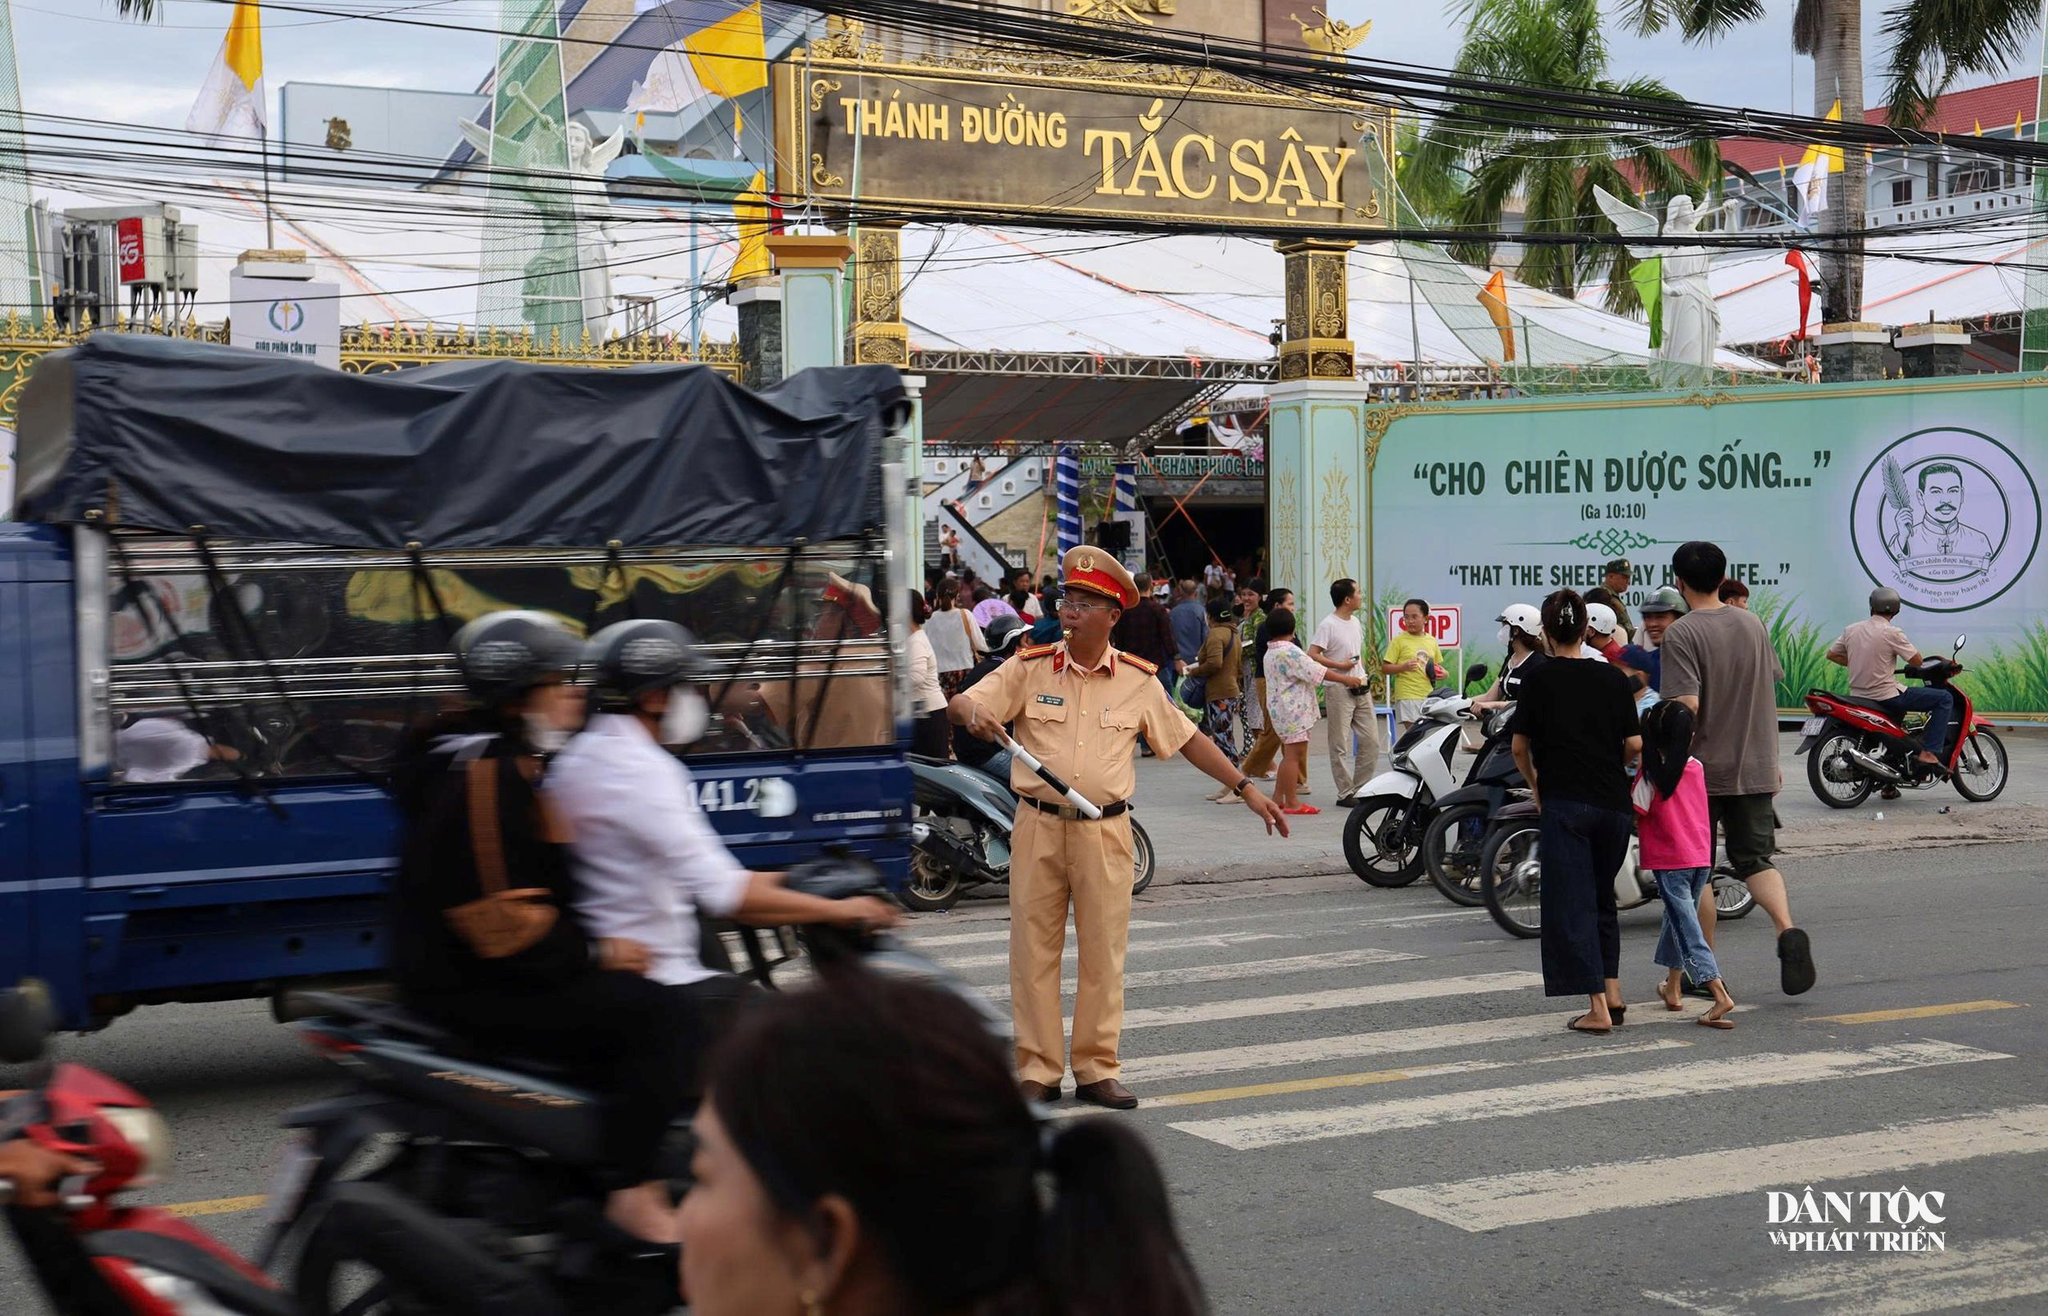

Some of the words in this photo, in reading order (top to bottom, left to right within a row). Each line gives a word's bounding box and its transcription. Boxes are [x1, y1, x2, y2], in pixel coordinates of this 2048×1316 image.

[840, 88, 949, 141] THÁNH
[961, 92, 1067, 149] ĐƯỜNG
[1083, 98, 1218, 200] TẮC
[1228, 126, 1356, 217] SẬY
[1160, 452, 1196, 476] CHÂN
[1414, 461, 1486, 496] “CHO
[1505, 450, 1593, 494] CHIÊN
[1604, 450, 1687, 499] ĐƯỢC
[1697, 439, 1831, 491] SỐNG...”
[1581, 504, 1601, 521] (Ga
[1606, 503, 1646, 520] 10:10)
[1449, 564, 1503, 586] “THAT
[1509, 564, 1543, 586] THE
[1628, 564, 1655, 586] AY
[1921, 588, 1943, 597] sheep
